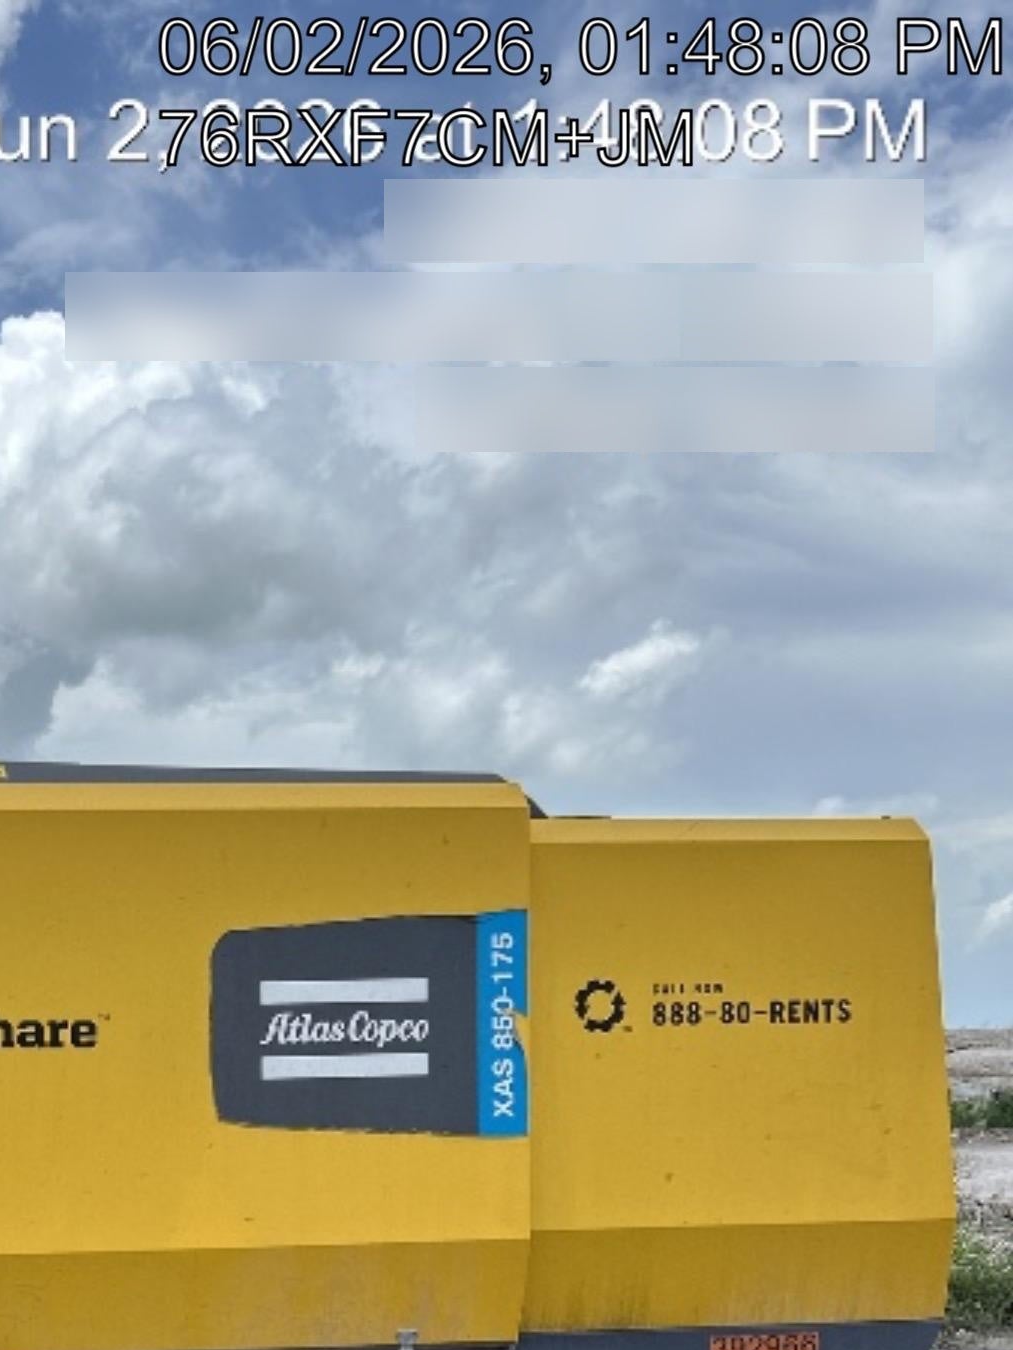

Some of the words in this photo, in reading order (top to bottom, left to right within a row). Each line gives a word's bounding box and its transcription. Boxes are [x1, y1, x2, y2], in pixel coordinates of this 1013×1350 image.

[491, 931, 515, 1050] 850-175
[652, 998, 852, 1026] 888-80-RENTS
[259, 1011, 345, 1045] Atlas
[347, 1010, 429, 1047] Copco
[492, 1057, 514, 1117] XAS
